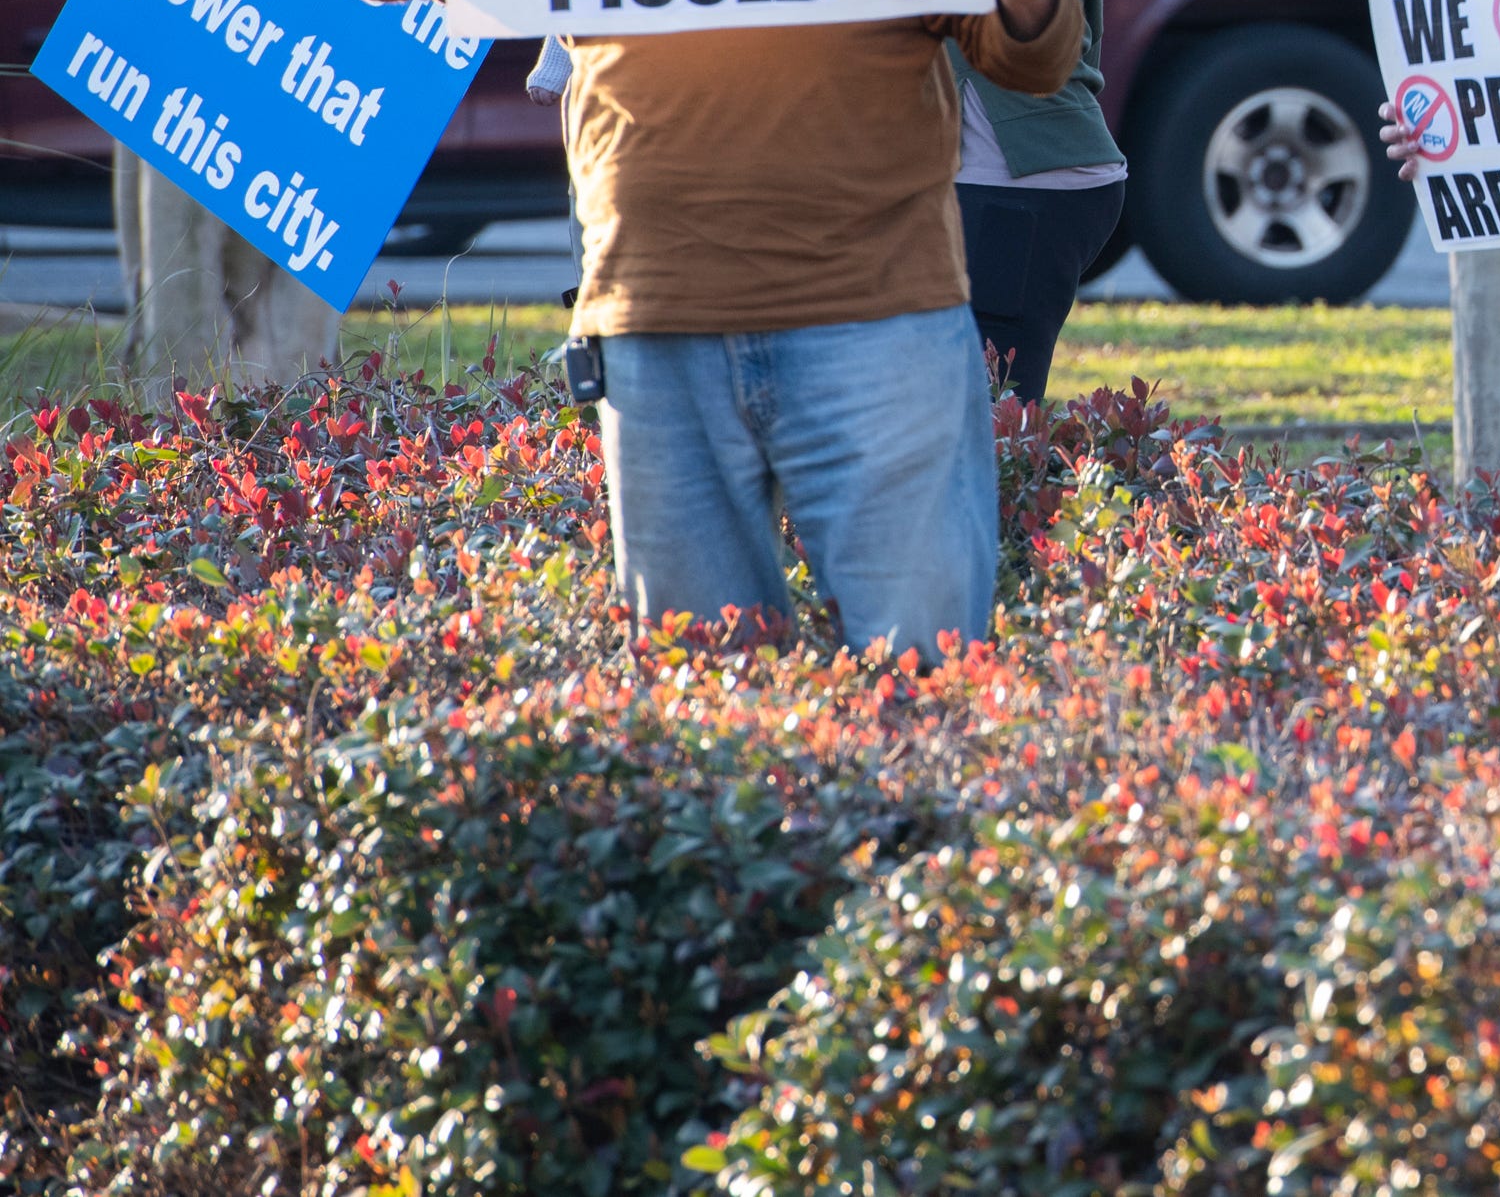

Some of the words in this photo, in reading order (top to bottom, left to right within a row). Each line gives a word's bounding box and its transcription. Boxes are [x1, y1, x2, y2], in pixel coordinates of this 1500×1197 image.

[66, 32, 151, 122] run
[151, 87, 241, 190] this
[244, 170, 340, 272] city.
[280, 34, 385, 147] that
